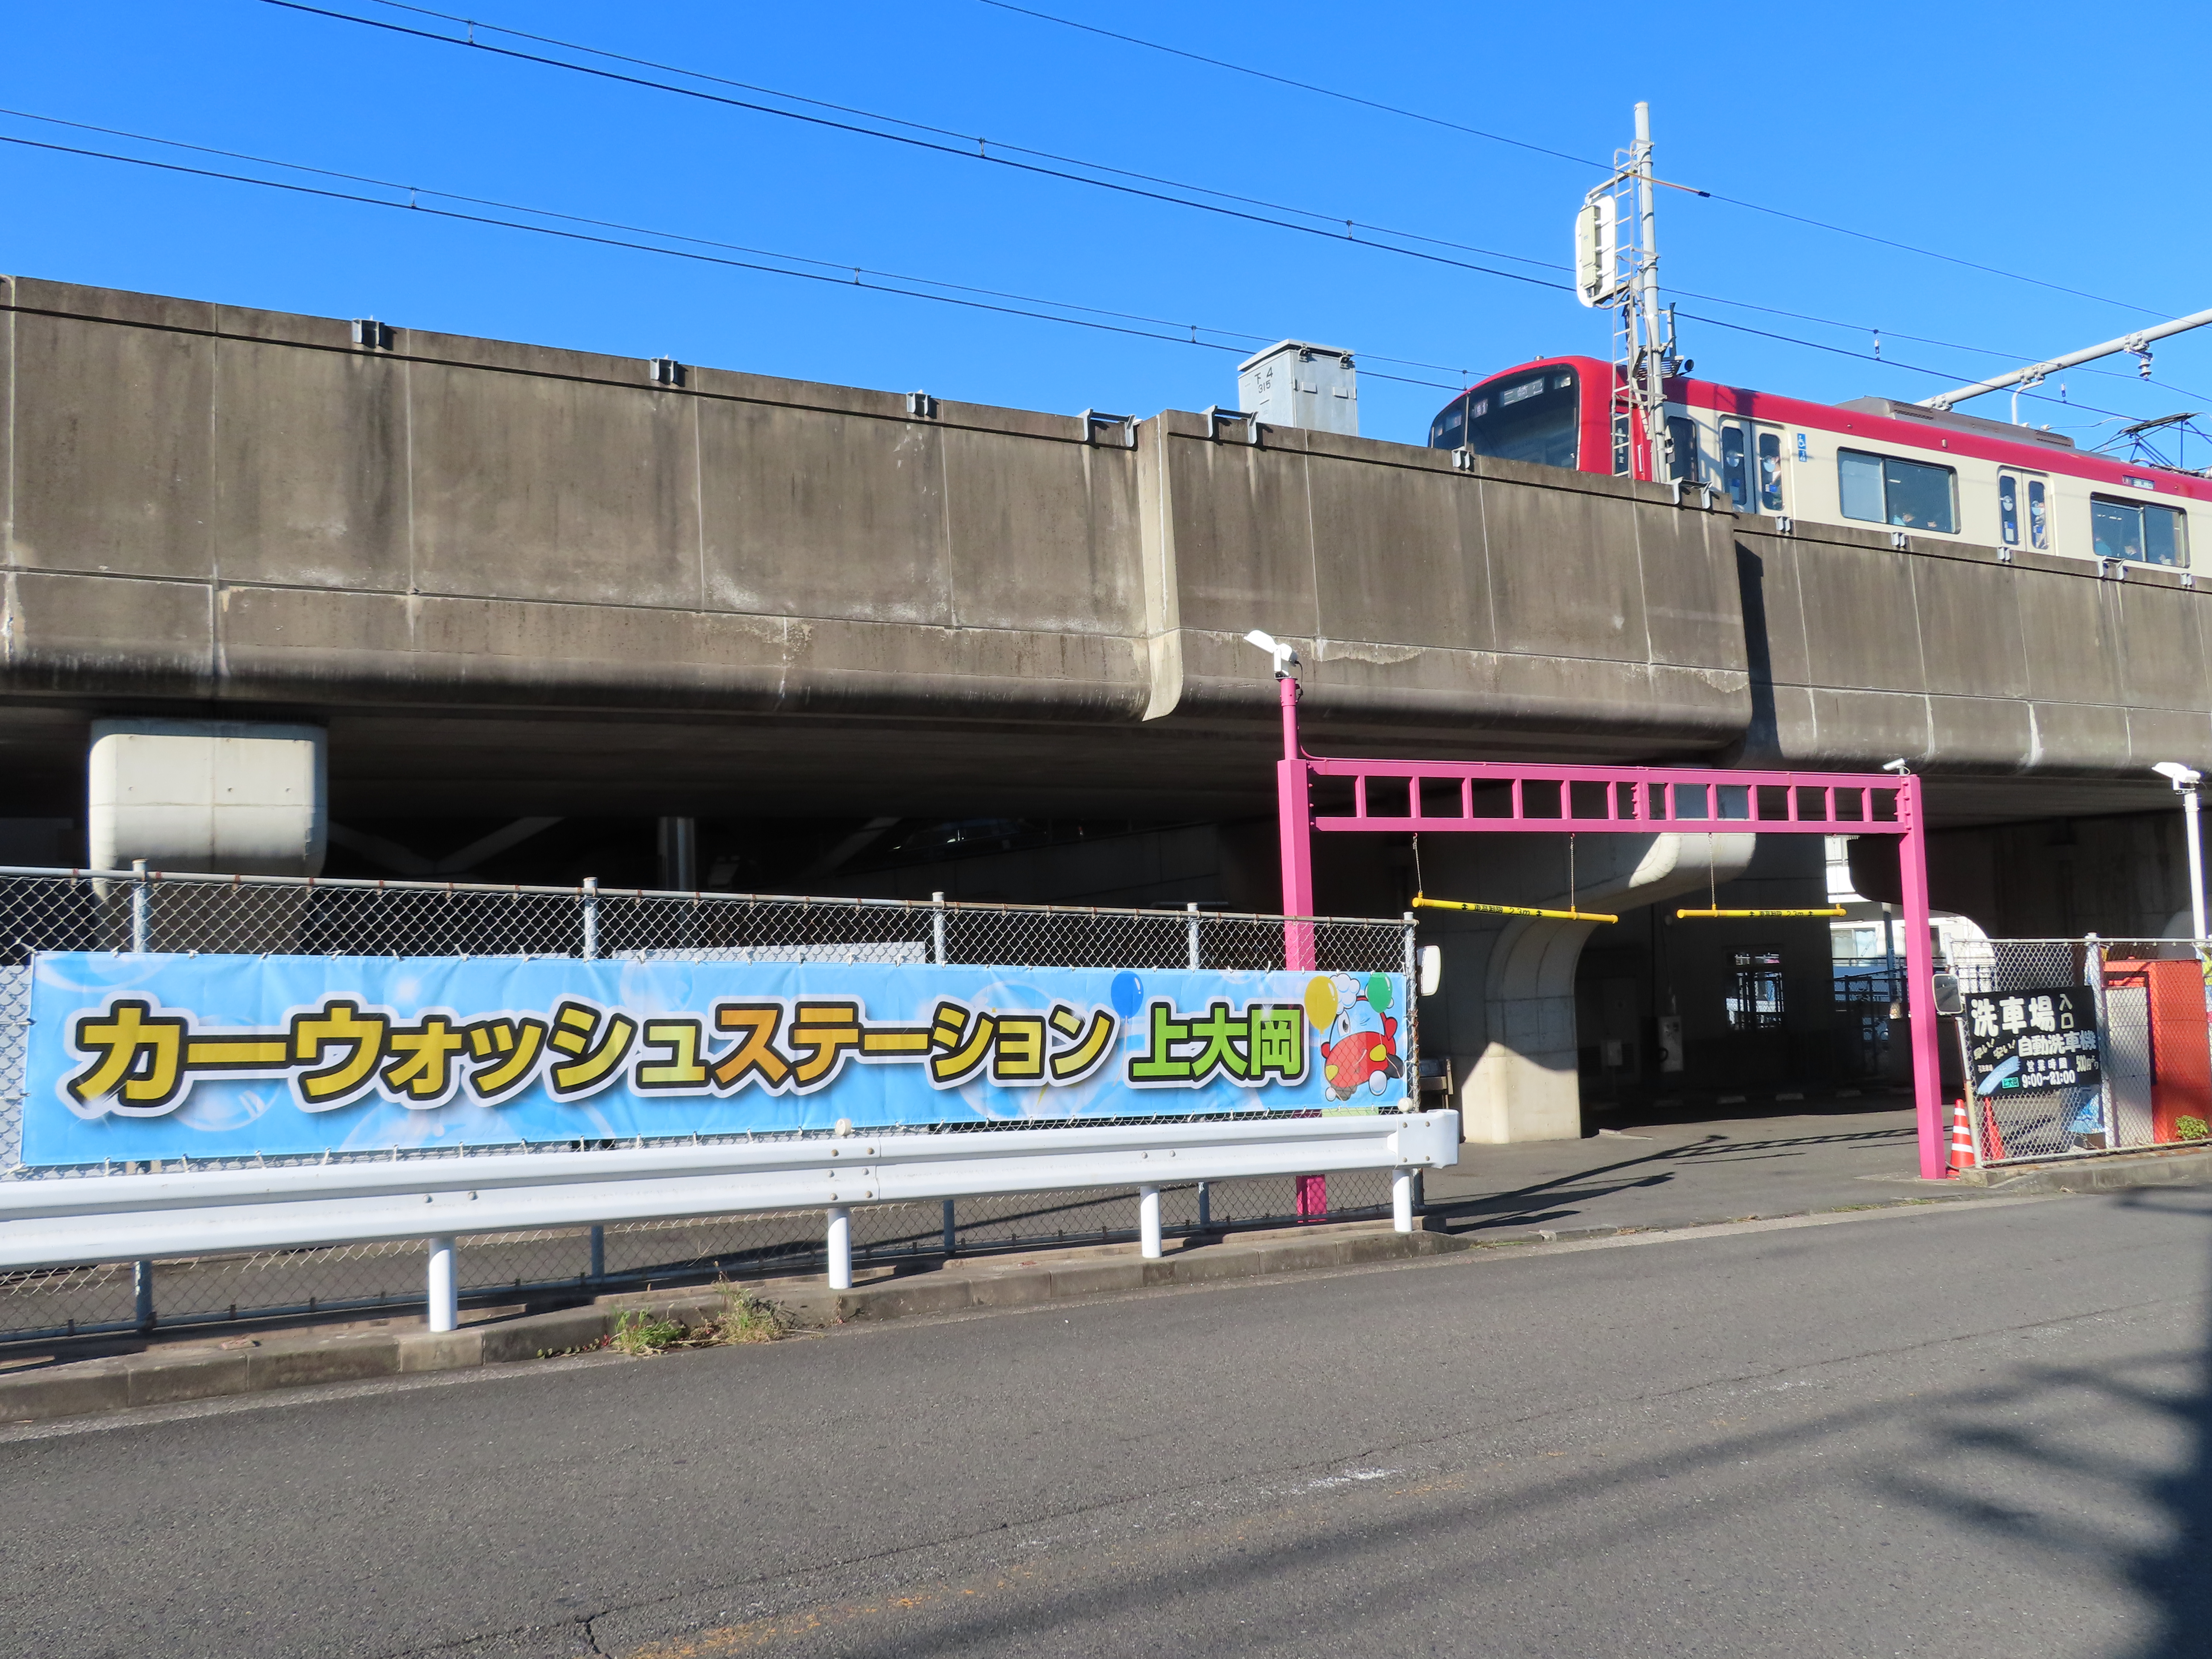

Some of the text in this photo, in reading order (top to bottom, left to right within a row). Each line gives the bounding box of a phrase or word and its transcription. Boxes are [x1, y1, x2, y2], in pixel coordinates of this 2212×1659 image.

[1266, 366, 1273, 378] 4
[1258, 379, 1271, 393] 315
[1971, 995, 2055, 1037] 洗車場
[2059, 993, 2074, 1029] 入口
[67, 999, 1305, 1107] カーウォッシュステーション 上大岡
[2018, 1030, 2096, 1057] 自動洗車機
[2026, 1057, 2068, 1072] 営業時間
[2003, 1078, 2018, 1087] 上大岡
